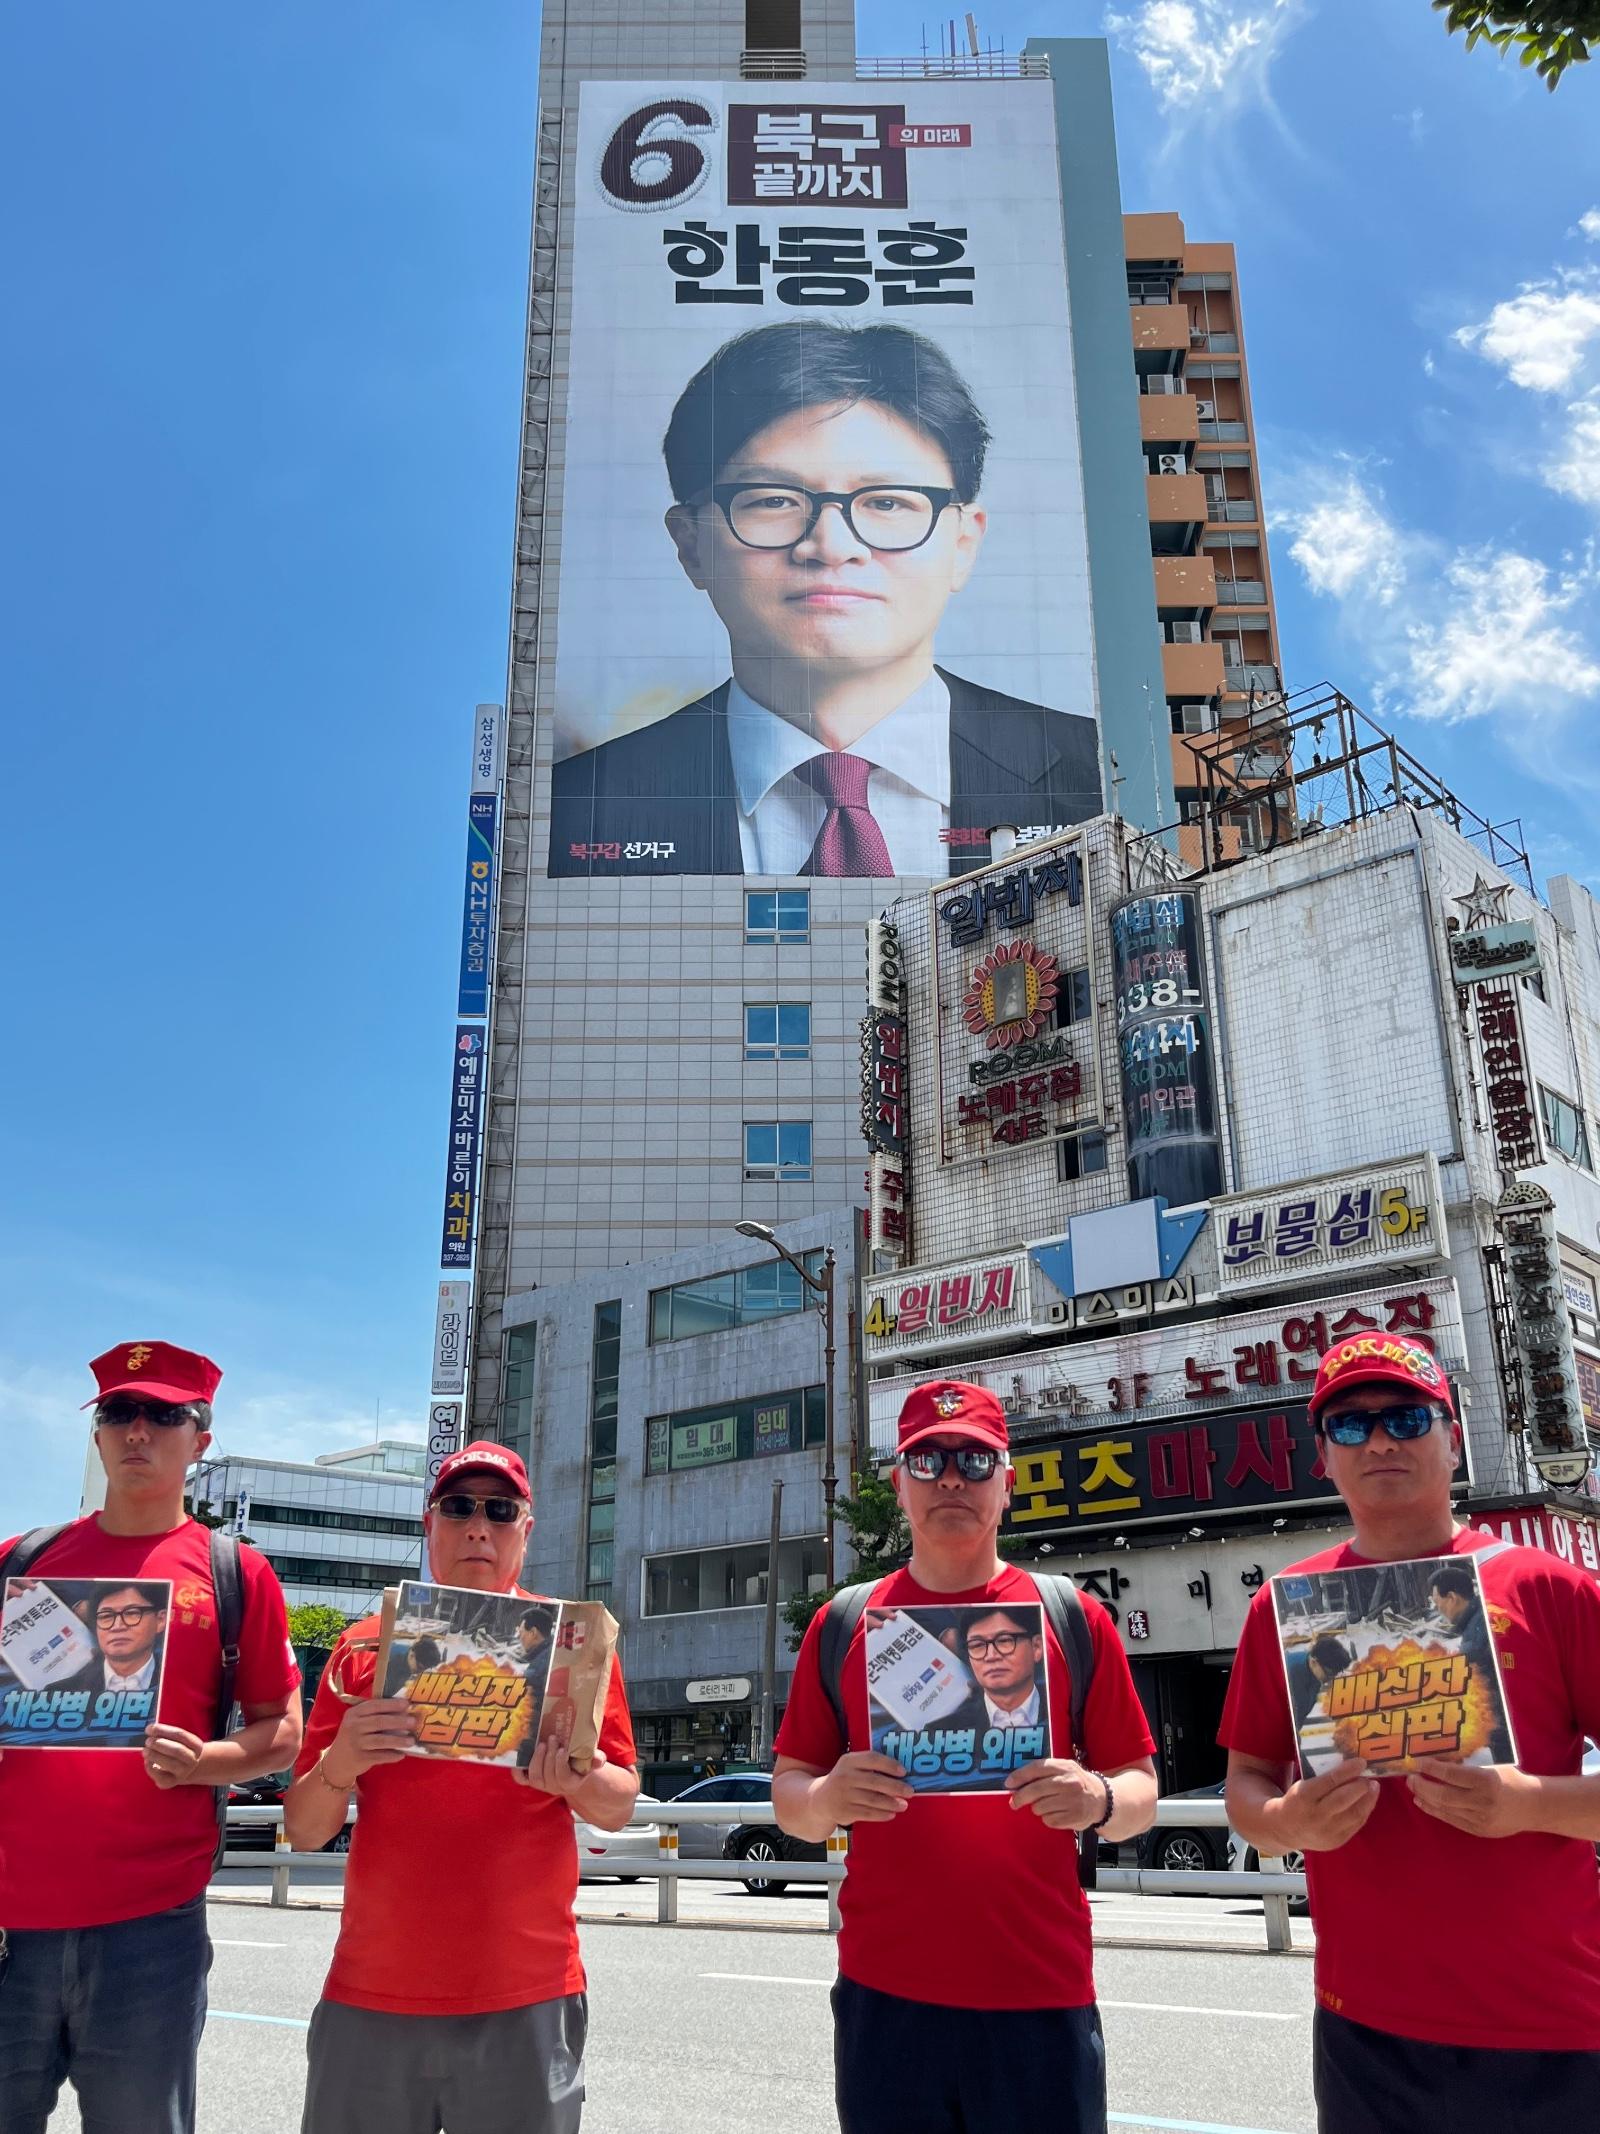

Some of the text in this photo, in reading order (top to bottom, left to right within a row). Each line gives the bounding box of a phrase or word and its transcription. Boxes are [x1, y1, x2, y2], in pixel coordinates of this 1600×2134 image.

[596, 95, 718, 212] 6
[753, 112, 880, 161] 북구
[922, 127, 960, 143] 미래
[752, 164, 882, 199] 끝까지
[663, 221, 975, 307] 한동훈
[478, 716, 495, 777] 삼성생명
[472, 804, 492, 812] NH
[568, 841, 677, 860] 북구갑 선거구
[939, 851, 1082, 948] 일번지
[969, 1036, 1073, 1084] ROOM
[957, 1062, 1081, 1126] 노래주점
[1223, 1186, 1428, 1265] 보물섬 5F
[864, 1265, 1016, 1337] 4F 일번지
[1048, 1274, 1195, 1329] 미스미시
[440, 1313, 461, 1367] 라이브
[1108, 1373, 1149, 1412] 3F
[757, 1408, 787, 1434] 임대
[2, 1690, 155, 1729] 채상병 외면
[408, 1672, 528, 1707] 배신자
[1329, 1654, 1472, 1718] 배신자
[417, 1708, 513, 1750] 심판
[882, 1726, 1045, 1774] 채상병 외면
[1358, 1700, 1465, 1763] 심판
